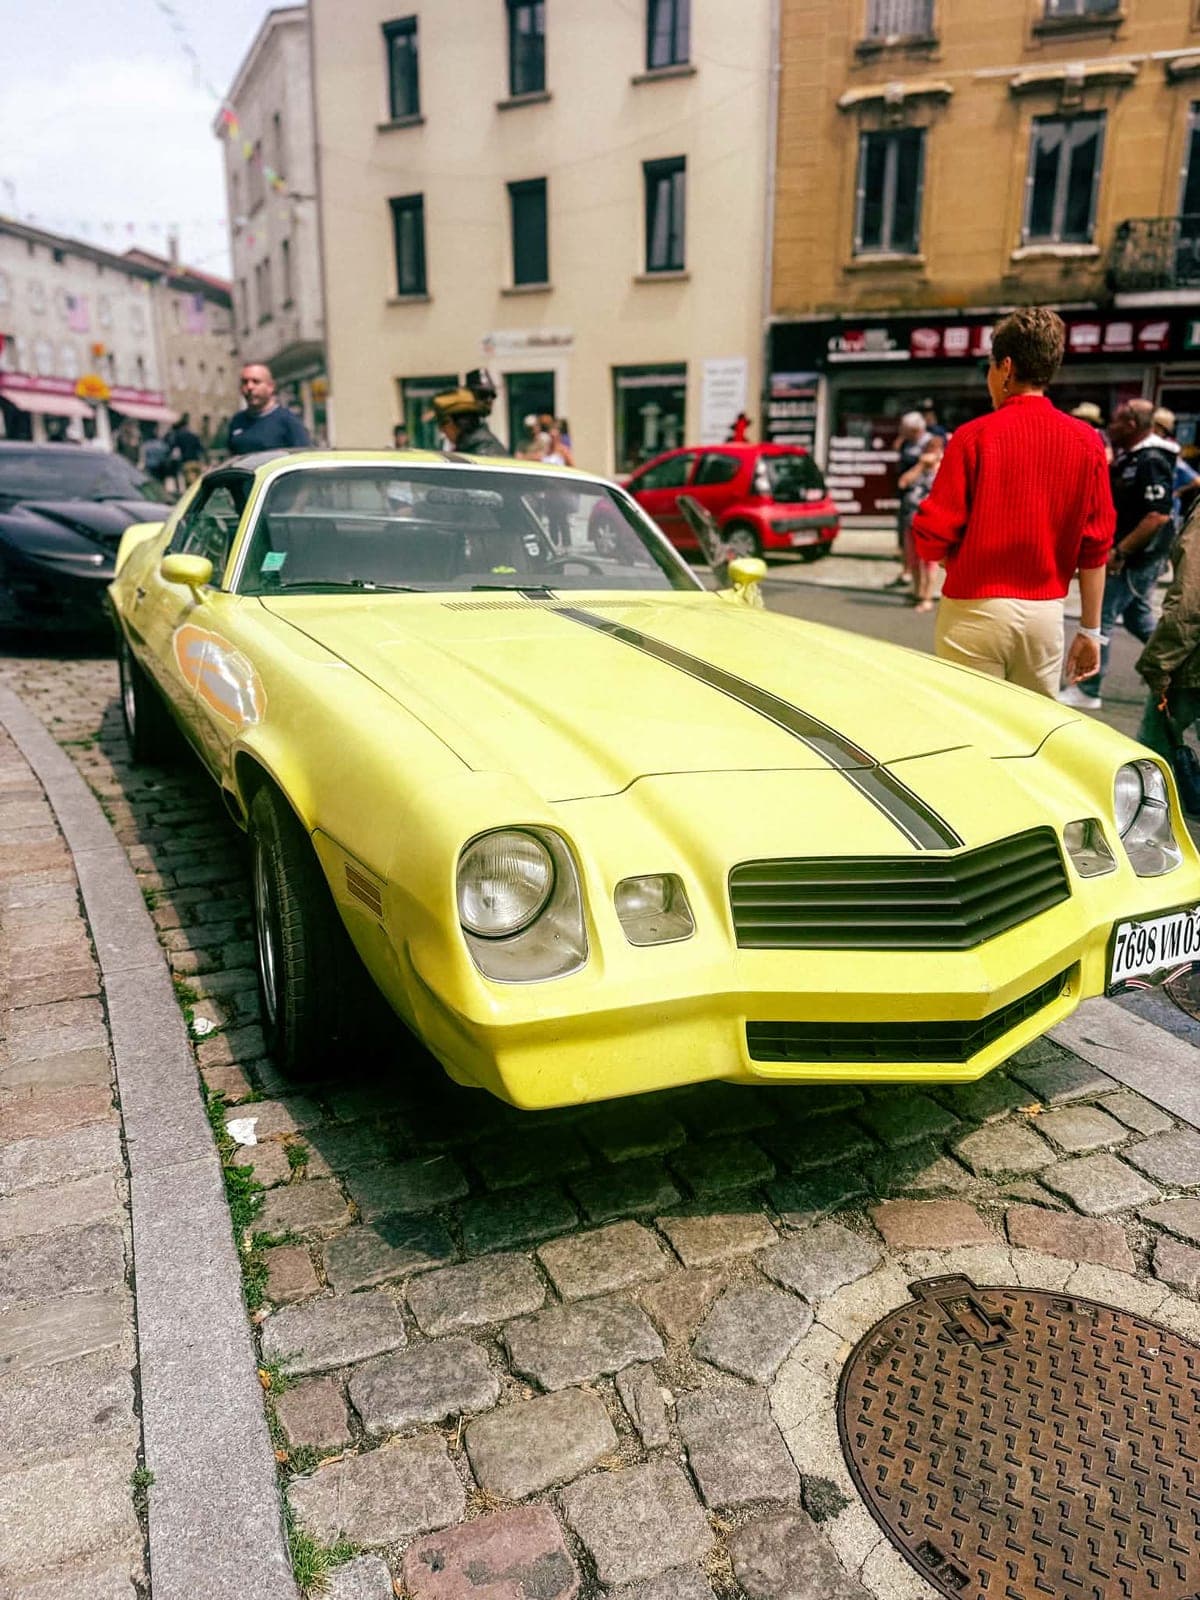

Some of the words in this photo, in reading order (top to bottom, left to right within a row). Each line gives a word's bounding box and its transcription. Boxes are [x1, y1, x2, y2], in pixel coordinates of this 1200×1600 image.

[1115, 926, 1157, 973] 7698
[1160, 919, 1183, 961] VM
[1183, 915, 1200, 954] 03
